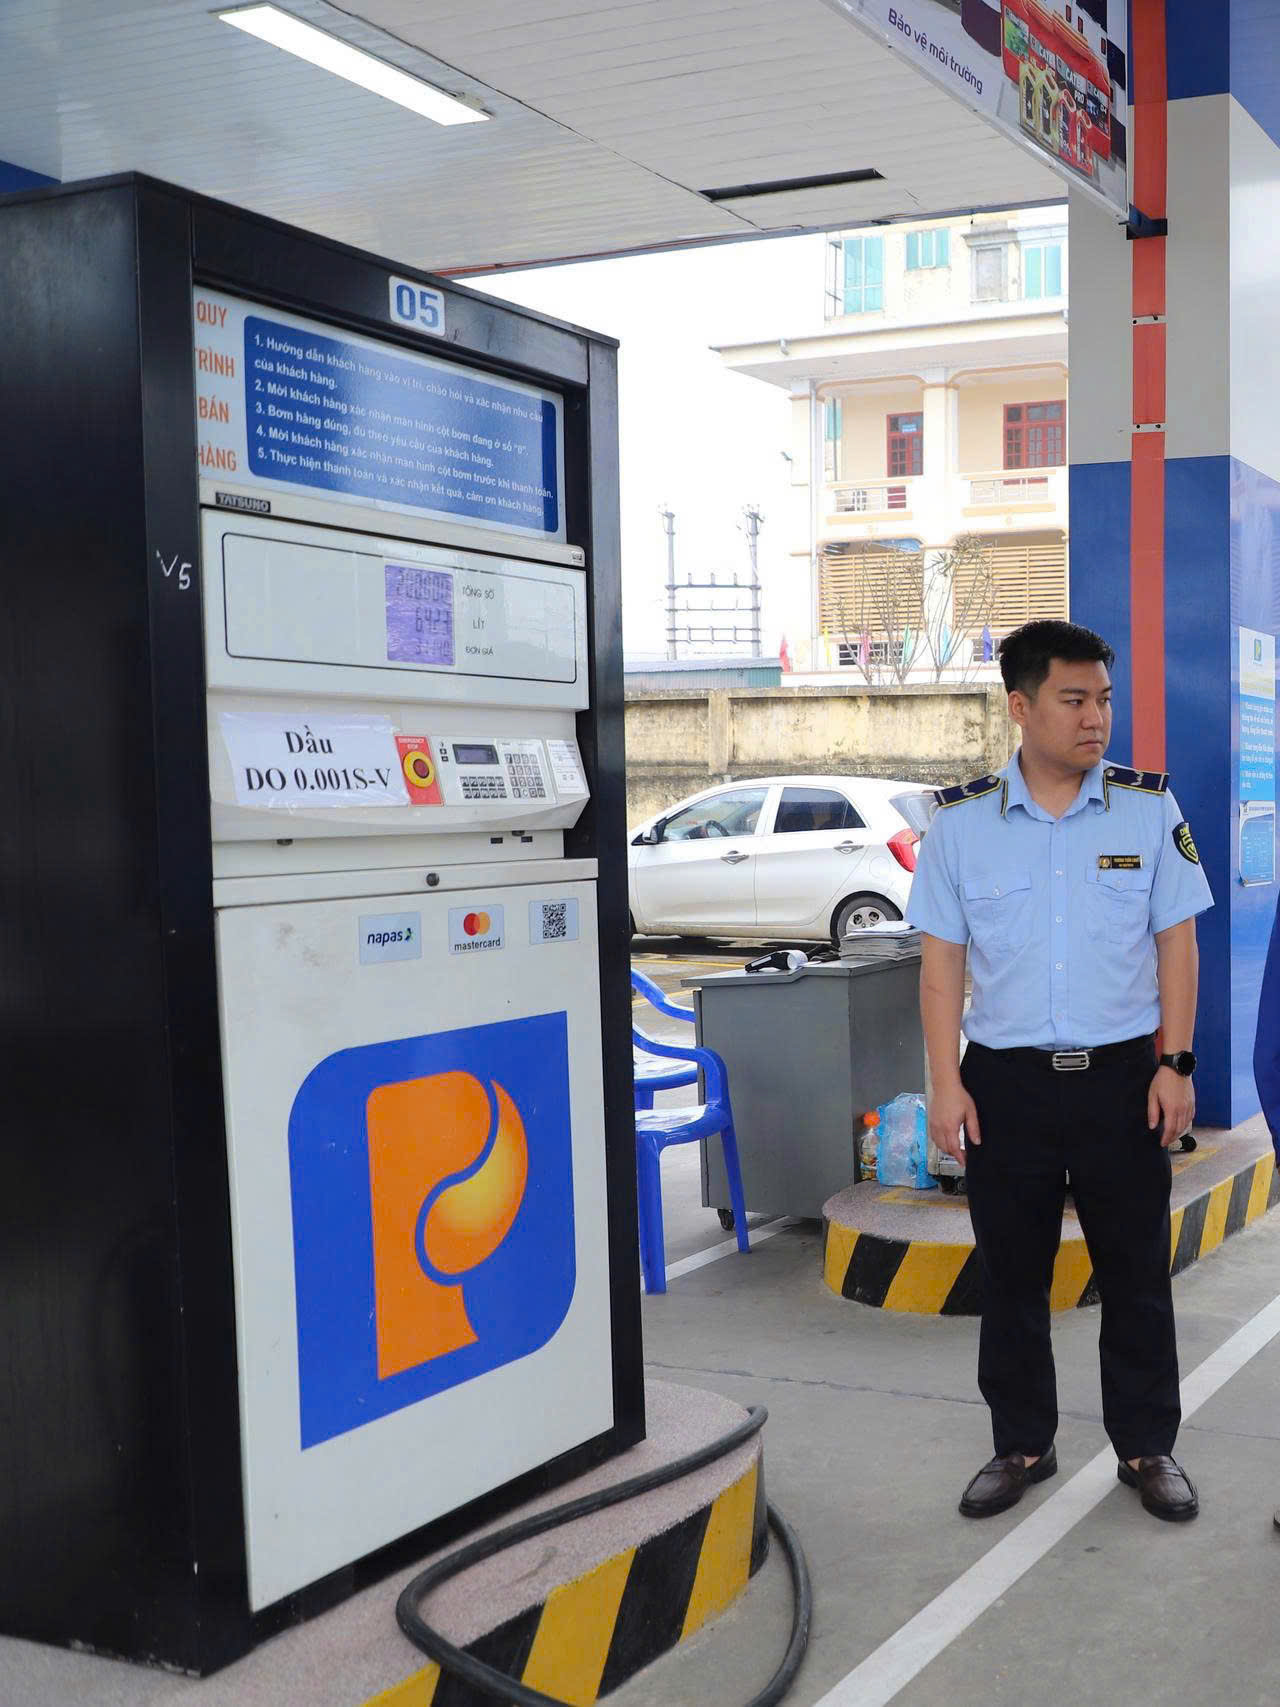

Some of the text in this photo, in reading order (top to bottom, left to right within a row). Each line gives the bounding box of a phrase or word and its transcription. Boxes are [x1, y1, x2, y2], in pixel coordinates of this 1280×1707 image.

[888, 8, 983, 95] Bảo vệ môi trường
[196, 301, 227, 329] QUY
[396, 284, 439, 328] 05
[254, 358, 338, 390] của khách hàng.
[254, 334, 264, 347] 1.
[266, 337, 303, 360] Hướng
[306, 349, 325, 363] dẫn
[326, 353, 356, 372] khách
[358, 362, 382, 381] hàng
[464, 391, 474, 403] và
[476, 396, 490, 408] xác
[513, 407, 528, 418] nhu
[198, 396, 230, 424] BÁN
[254, 379, 265, 393] 2.
[267, 381, 288, 398] Mời
[290, 386, 320, 406] khách
[323, 395, 348, 415] hàng
[350, 404, 366, 416] xác
[436, 425, 450, 438] cột
[452, 428, 471, 443] bơm
[472, 434, 493, 450] đang
[502, 440, 512, 452] số
[256, 402, 265, 415] 3.
[268, 404, 293, 421] Bơm
[296, 411, 321, 430] hàng
[444, 446, 470, 462] khách
[472, 452, 494, 468] hàng.
[256, 424, 266, 437] 4.
[268, 426, 289, 440] Mời
[292, 431, 322, 448] khách
[324, 439, 348, 457] hàng
[351, 446, 368, 458] xác
[438, 465, 452, 478] cột
[452, 467, 472, 480] bơm
[474, 472, 496, 486] trước
[498, 478, 510, 489] khi
[512, 480, 533, 495] thanh
[535, 486, 554, 499] toán.
[258, 447, 267, 460] 5.
[270, 449, 297, 467] Thực
[300, 456, 321, 471] hiện
[323, 461, 351, 476] thanh
[466, 490, 484, 503] cảm
[486, 496, 496, 506] ơn
[498, 496, 522, 511] khách
[472, 617, 484, 630] LÍT
[285, 724, 334, 754] Dầu
[245, 768, 392, 791] DO 0.001S-V
[367, 929, 403, 947] napas
[454, 936, 501, 952] mastercard
